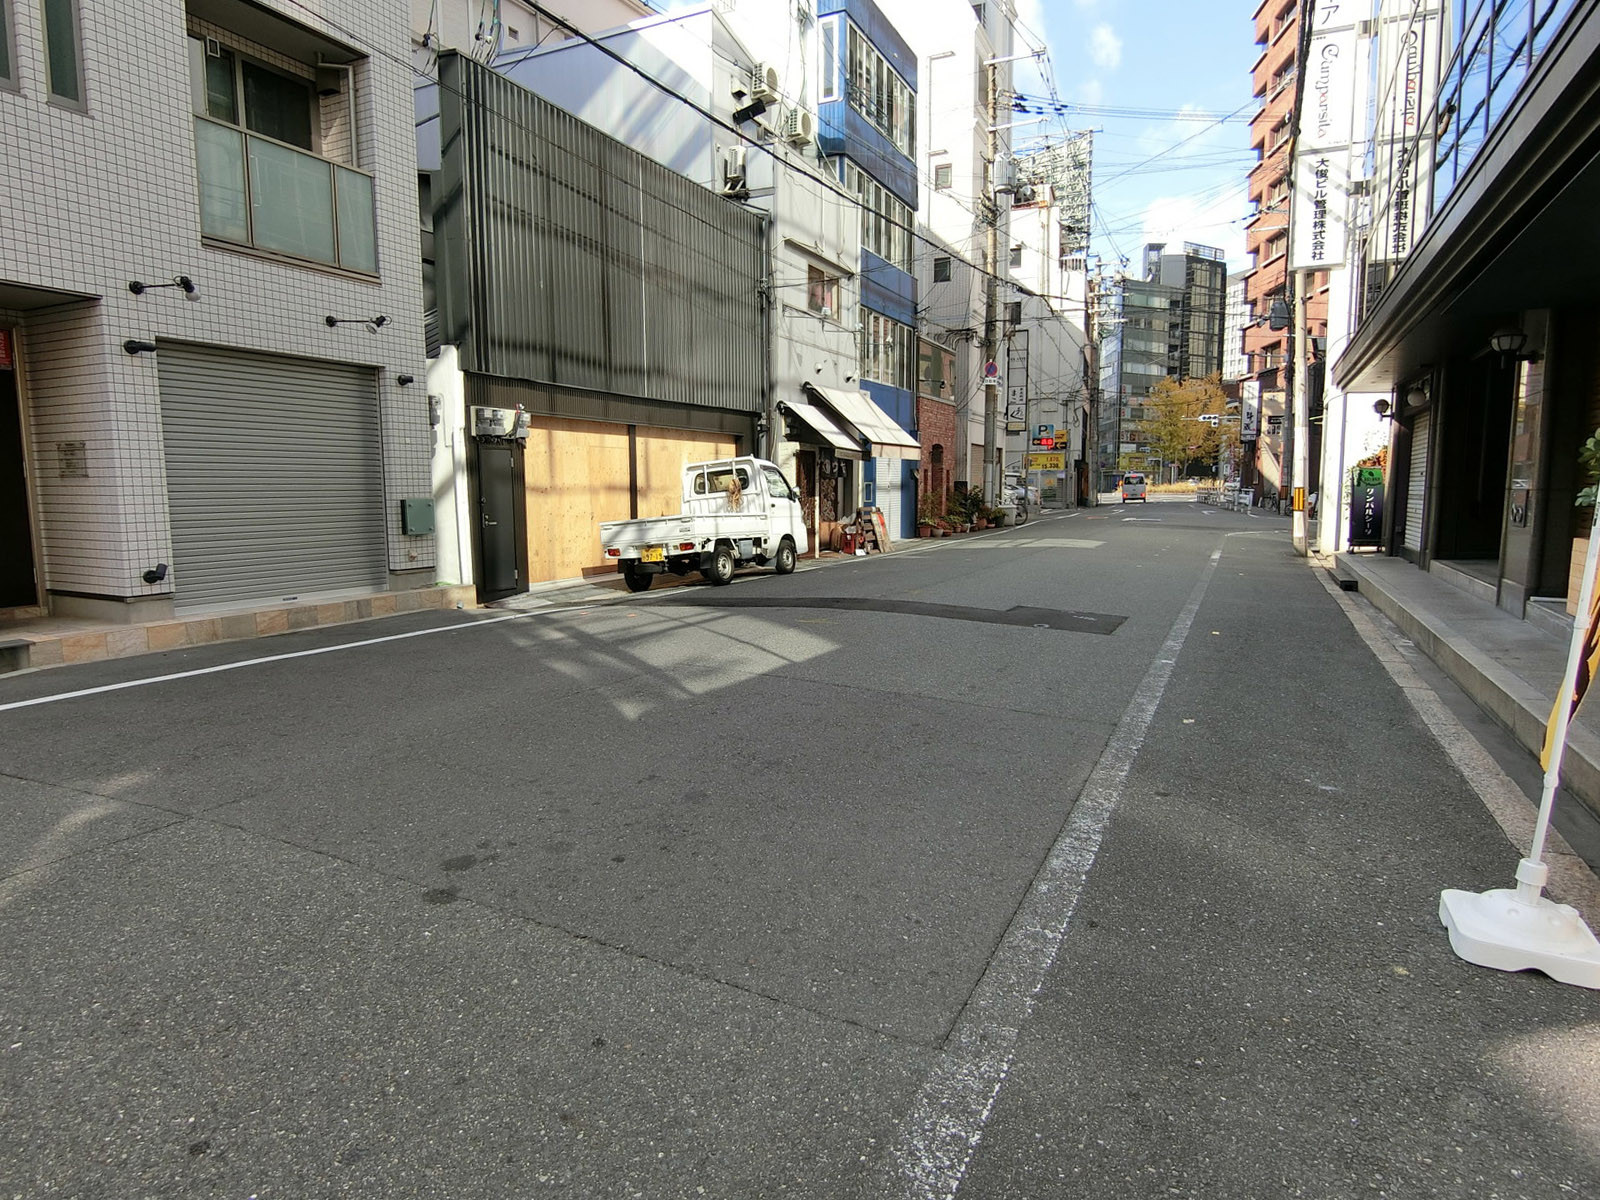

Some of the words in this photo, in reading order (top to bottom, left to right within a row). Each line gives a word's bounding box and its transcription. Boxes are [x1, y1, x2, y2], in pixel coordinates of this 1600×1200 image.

[1311, 158, 1330, 261] 大俊ビル管理株式会社
